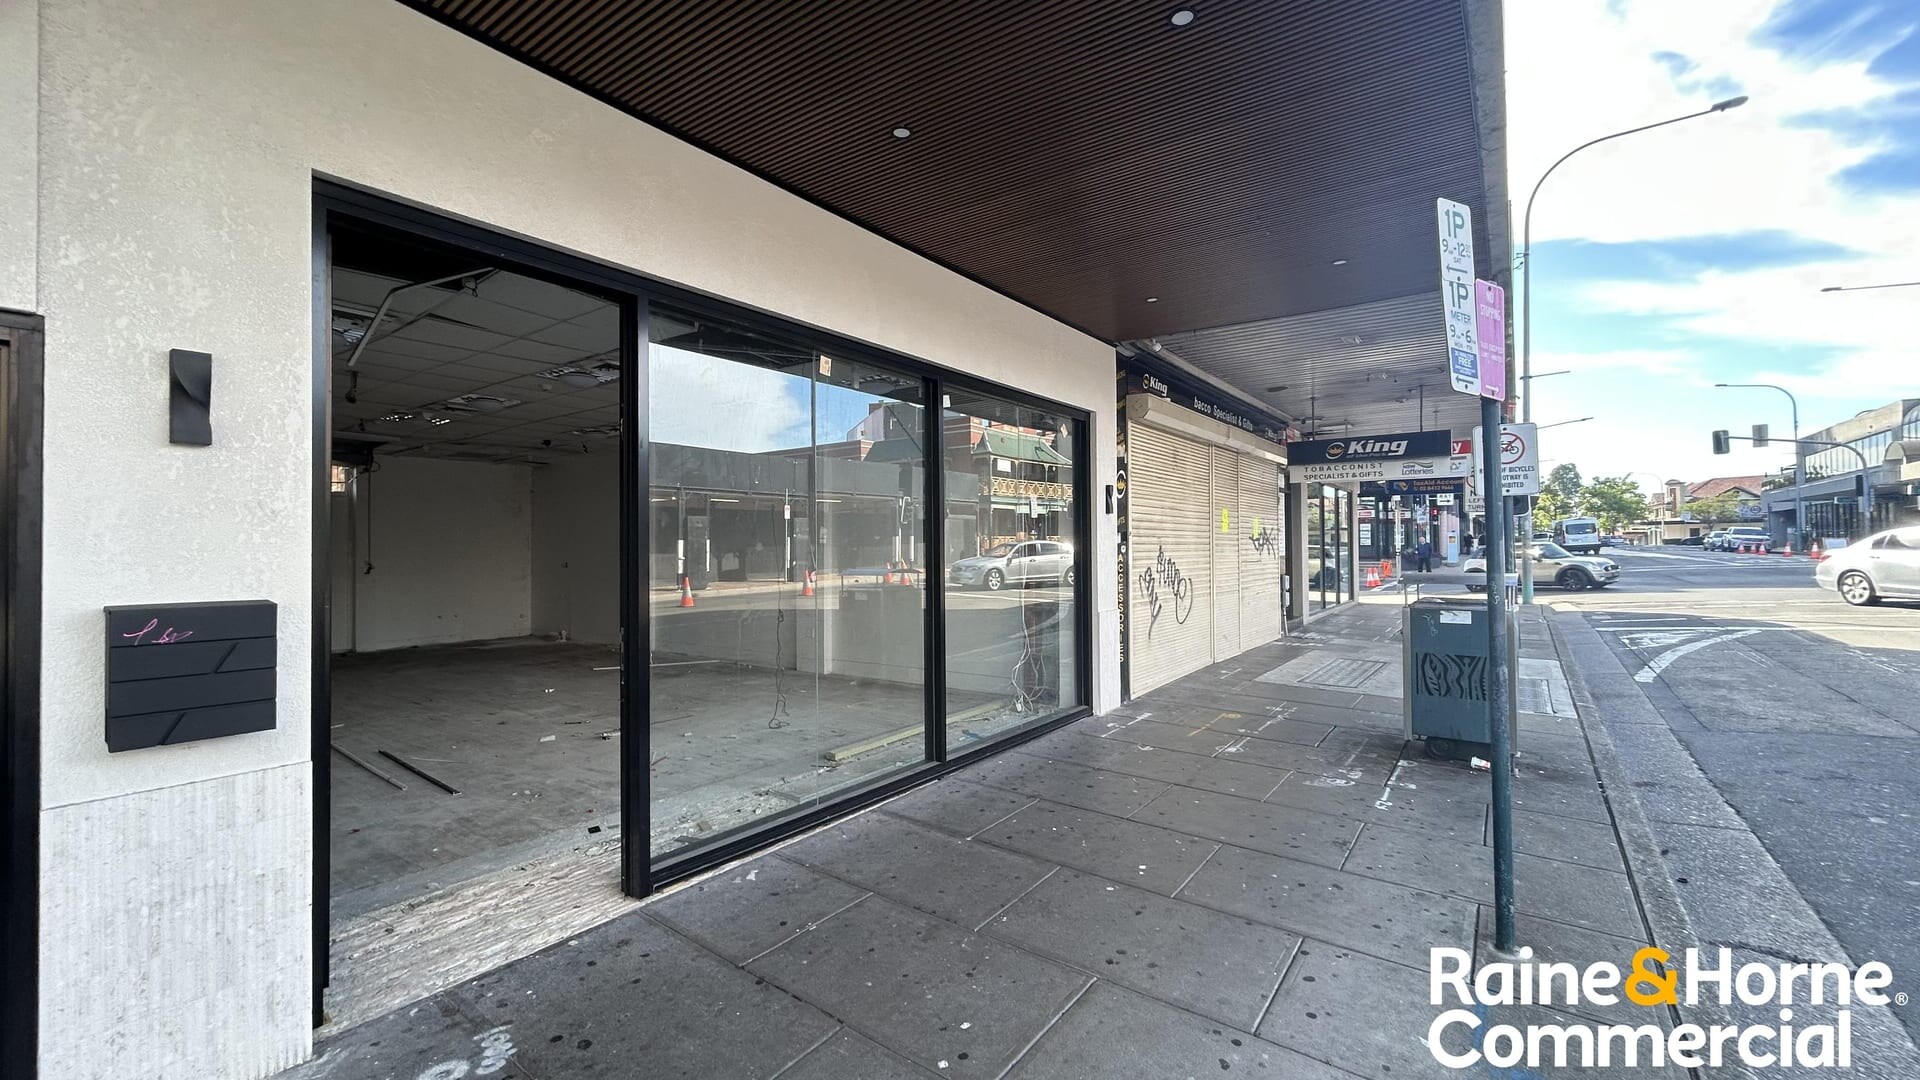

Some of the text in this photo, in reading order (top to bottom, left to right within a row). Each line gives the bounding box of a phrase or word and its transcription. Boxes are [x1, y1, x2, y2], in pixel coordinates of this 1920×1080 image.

[1444, 208, 1465, 239] 1P
[1448, 280, 1469, 309] 1P
[1149, 376, 1168, 397] King
[1346, 439, 1409, 457] King
[1303, 471, 1350, 481] SPECIALIST
[1359, 470, 1384, 479] GIFTS
[1304, 462, 1384, 474] TOBACCONIST
[1401, 468, 1434, 476] Lotteries
[1508, 465, 1535, 473] BICYCLES
[1117, 553, 1125, 663] ACCESSORIES
